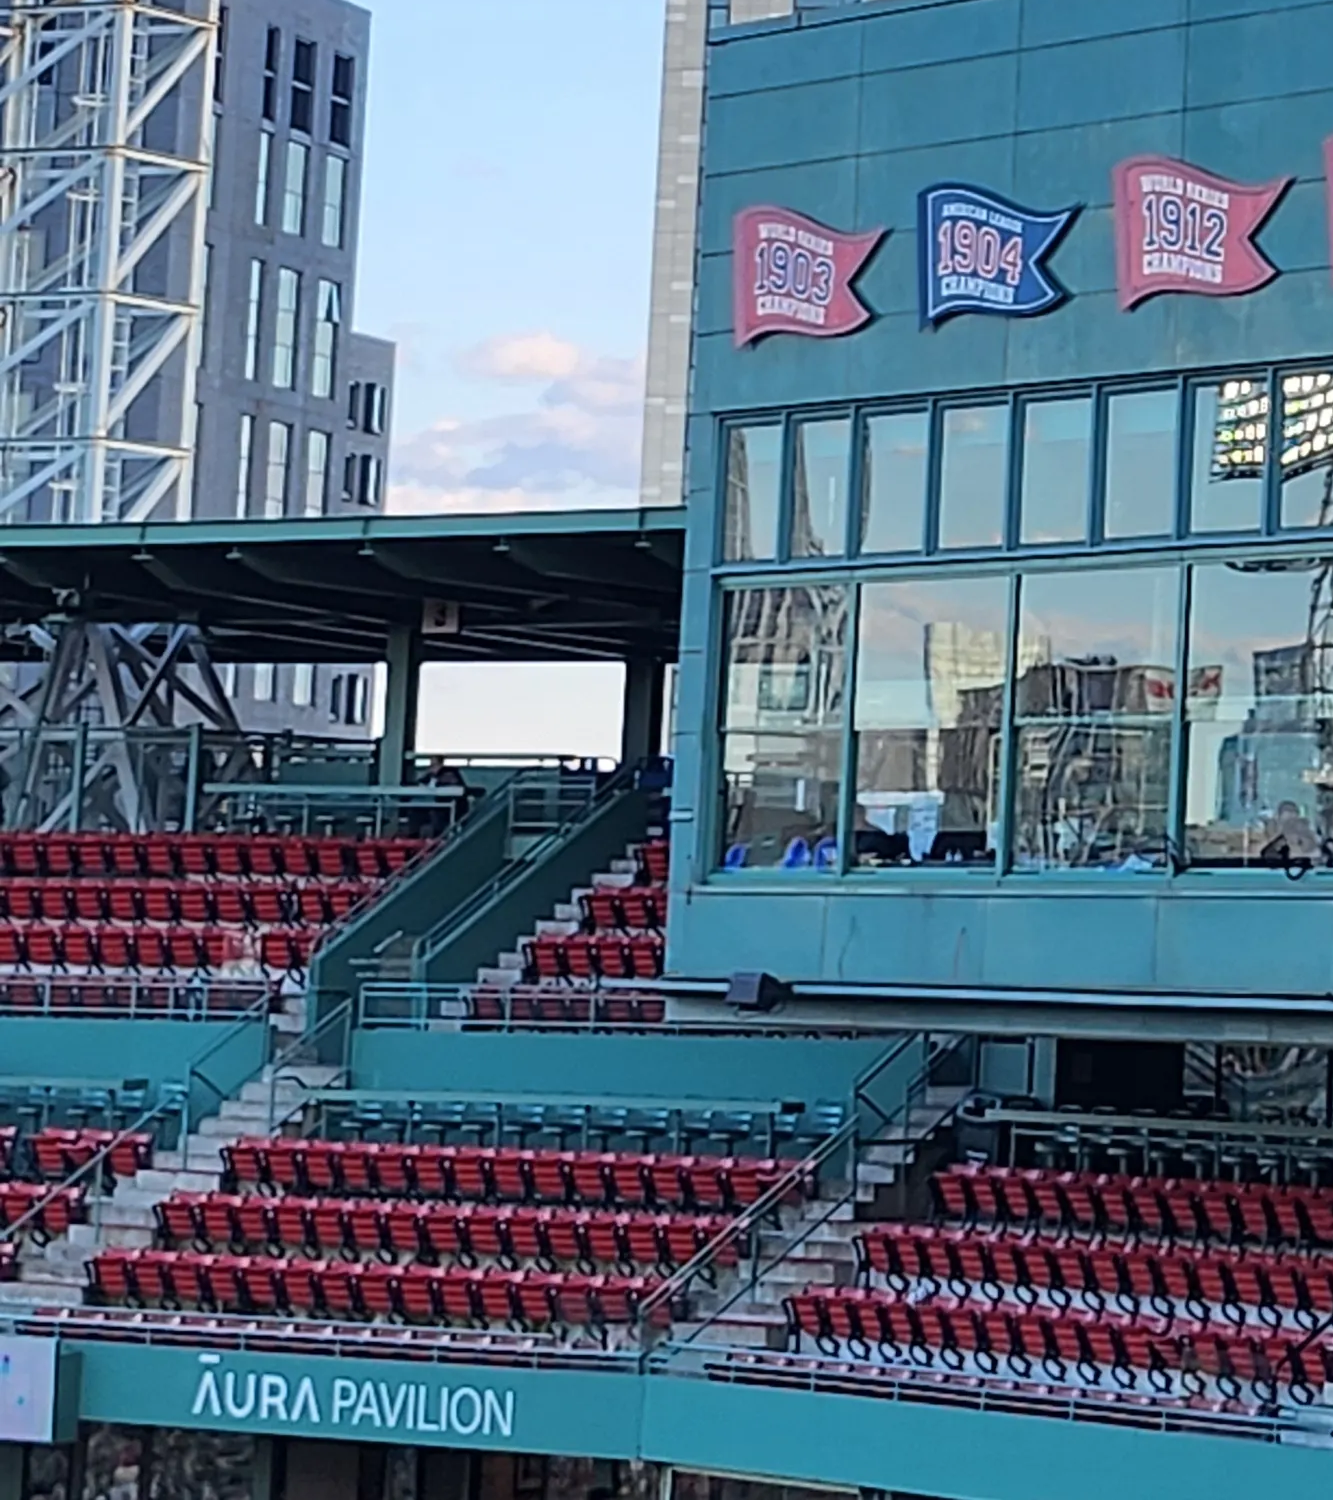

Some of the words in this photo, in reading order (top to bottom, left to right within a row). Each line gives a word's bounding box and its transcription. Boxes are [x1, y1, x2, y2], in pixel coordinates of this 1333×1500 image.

[937, 220, 1022, 286] 1904
[1143, 194, 1228, 262] 1912
[753, 241, 835, 306] 1903
[941, 275, 1015, 304] CHAMPIONS
[1143, 252, 1223, 284] CHAMPIONS
[331, 1377, 515, 1437] PAVILION
